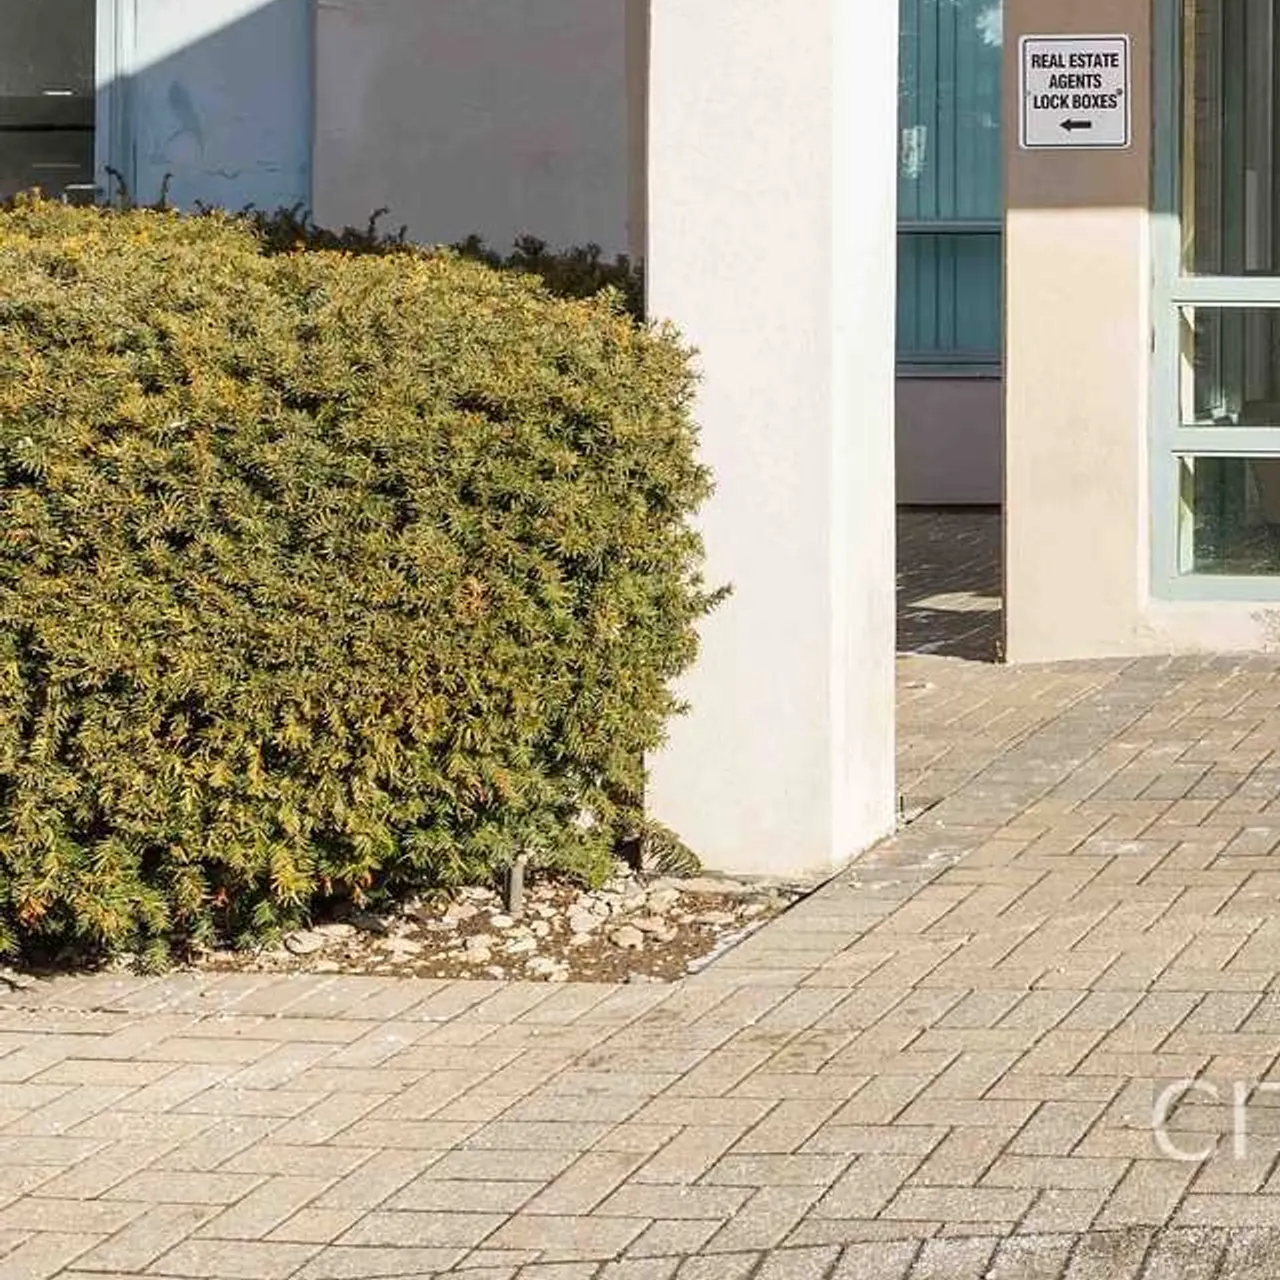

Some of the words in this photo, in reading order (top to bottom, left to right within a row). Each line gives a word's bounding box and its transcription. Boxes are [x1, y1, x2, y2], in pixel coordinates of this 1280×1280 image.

[1031, 54, 1066, 69] REAL
[1069, 53, 1119, 68] ESTATE
[1048, 74, 1102, 89] AGENTS
[1033, 94, 1070, 109] LOCK
[1072, 94, 1118, 109] BOXES
